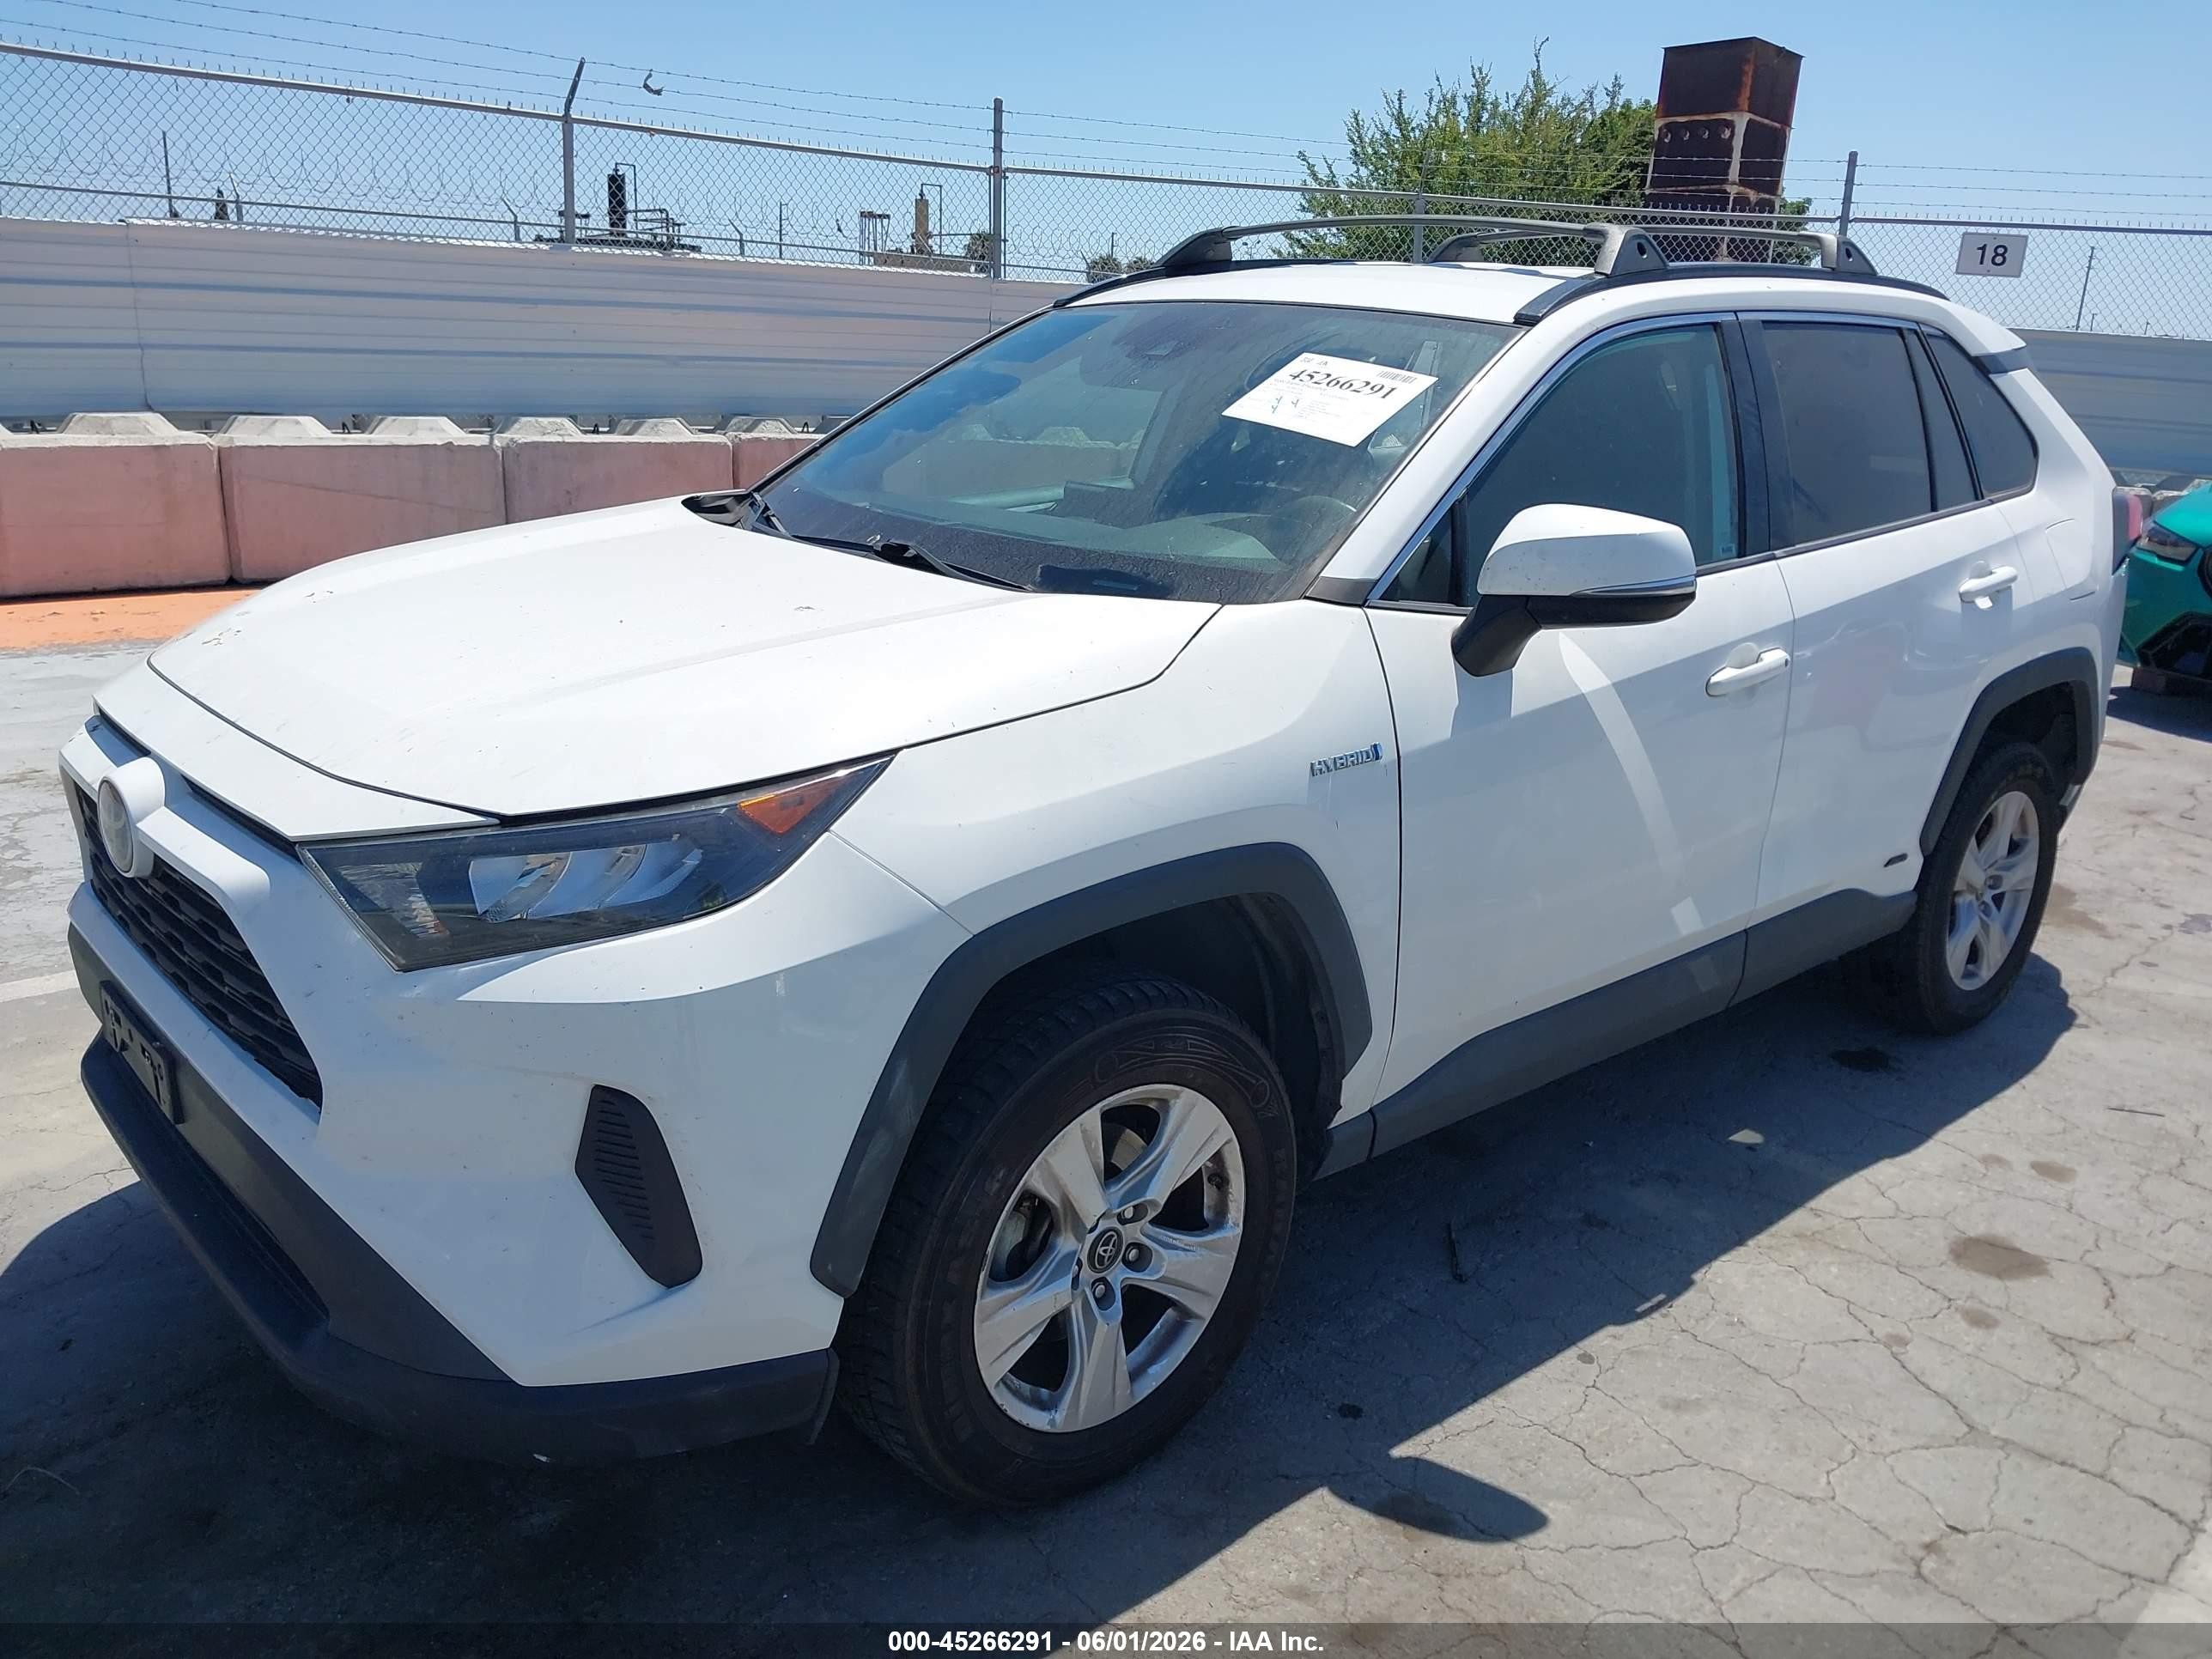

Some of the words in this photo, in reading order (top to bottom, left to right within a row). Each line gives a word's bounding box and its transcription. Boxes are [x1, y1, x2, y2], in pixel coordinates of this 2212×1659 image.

[1976, 243, 2008, 267] 18
[1289, 368, 1398, 399] 45266291
[1310, 747, 1375, 777] HYBRID
